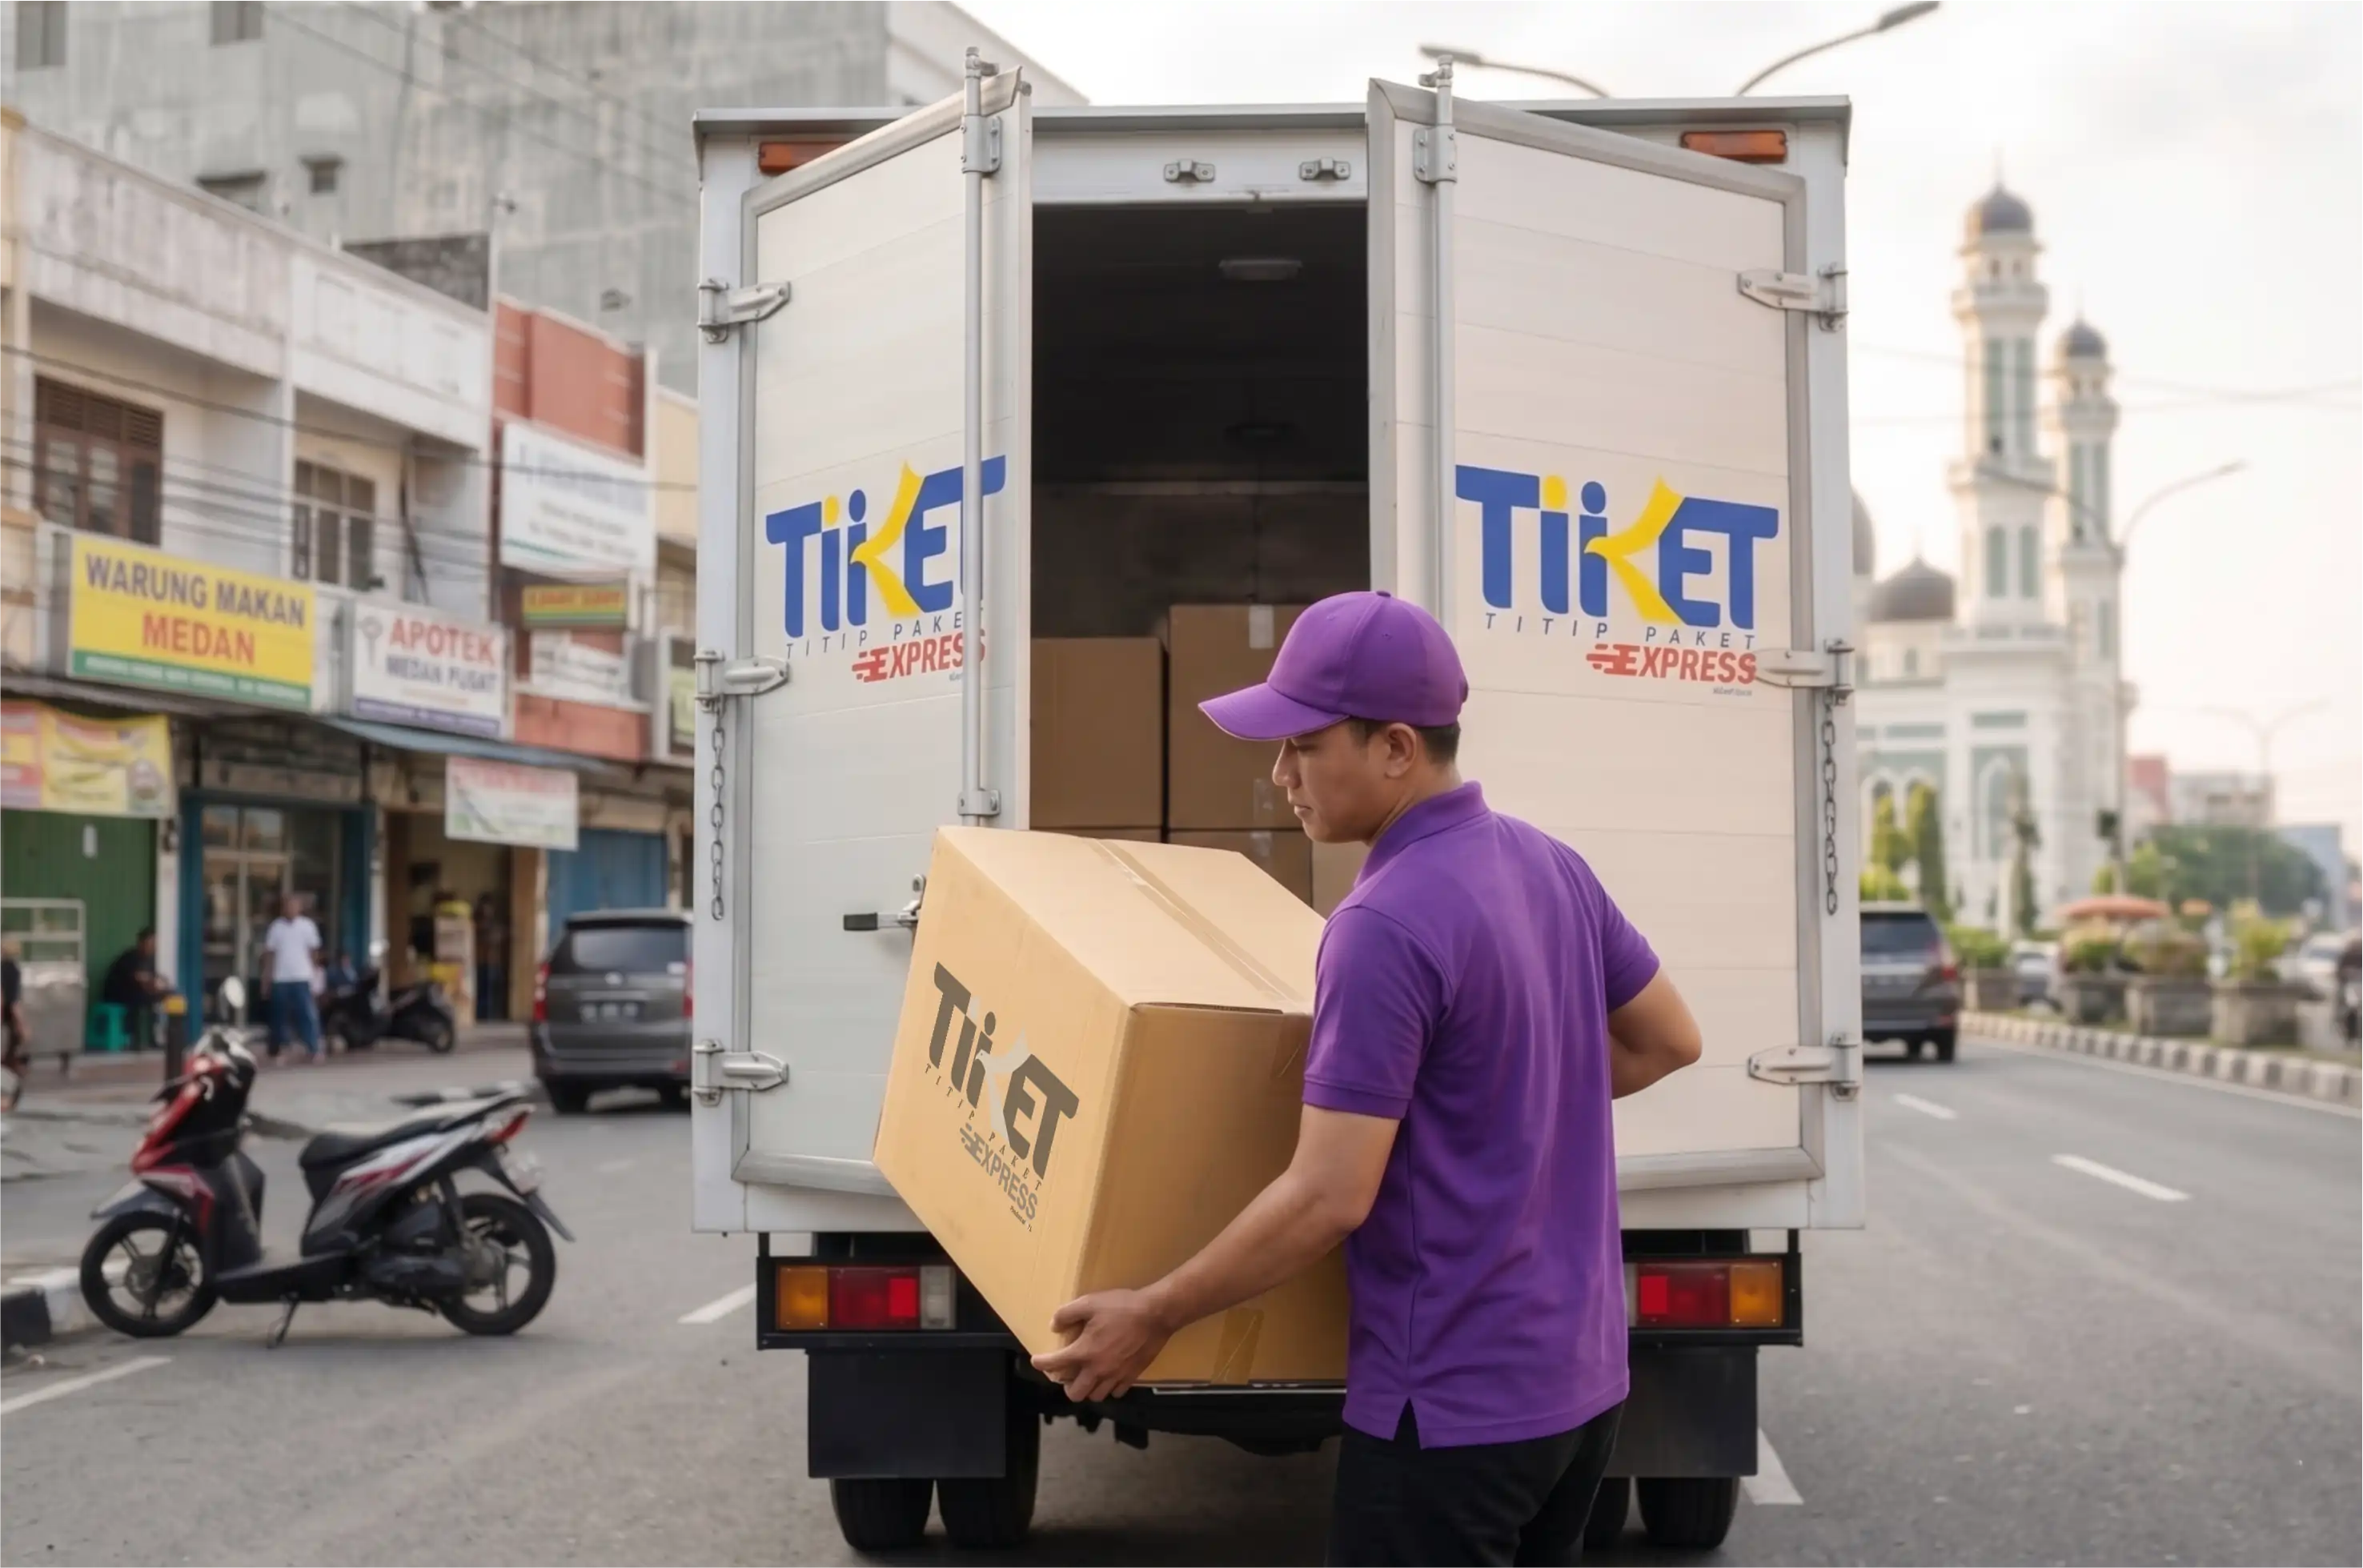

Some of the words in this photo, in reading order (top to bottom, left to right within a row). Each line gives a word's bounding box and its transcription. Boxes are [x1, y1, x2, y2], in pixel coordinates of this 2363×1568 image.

[86, 552, 208, 610] WARUNG
[215, 578, 306, 630] MAKAN
[142, 612, 255, 667] MEDAN
[389, 617, 495, 666] APOTEK
[786, 630, 867, 660] TITIP
[894, 608, 983, 640] PAKE
[1486, 612, 1608, 639] TITIP
[1645, 626, 1755, 650] PAKET
[1587, 644, 1756, 684] EXPRESS
[925, 1063, 975, 1121] TITIP
[988, 1131, 1042, 1192] PAKET
[960, 1123, 1038, 1221] EXPRESS
